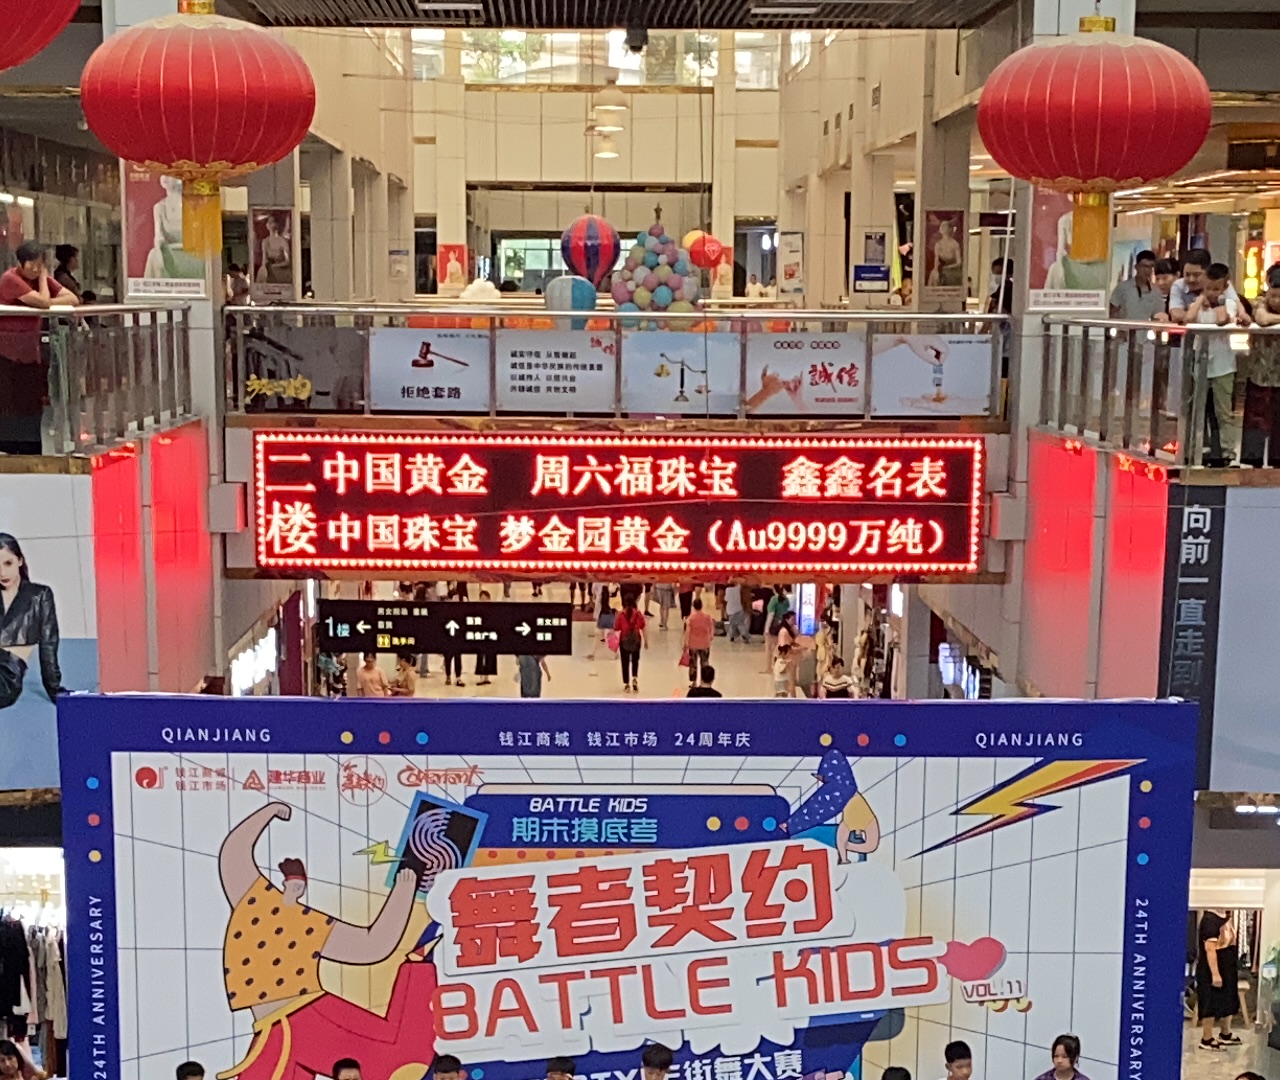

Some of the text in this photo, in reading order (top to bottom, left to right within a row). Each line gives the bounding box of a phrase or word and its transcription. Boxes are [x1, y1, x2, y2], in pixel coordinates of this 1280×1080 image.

[401, 385, 462, 399] 拒绝套路
[322, 450, 948, 498] 中国黄金 周六福珠宝 鑫鑫名表
[327, 511, 479, 552] 中国珠宝
[161, 727, 271, 743] QIANJIANG
[498, 731, 752, 747] 钱江商城 钱江市场 24周年庆
[975, 733, 1084, 747] QIANJIANG
[529, 798, 648, 813] BATTLE KIDS
[511, 817, 658, 844] 期末摸底考
[448, 844, 834, 968] 舞者契约
[89, 895, 107, 1080] 24TH ANNIVERSARY
[432, 936, 939, 1042] BATTLE KIDS
[1129, 898, 1149, 1080] 24TH ANNIVERSARY
